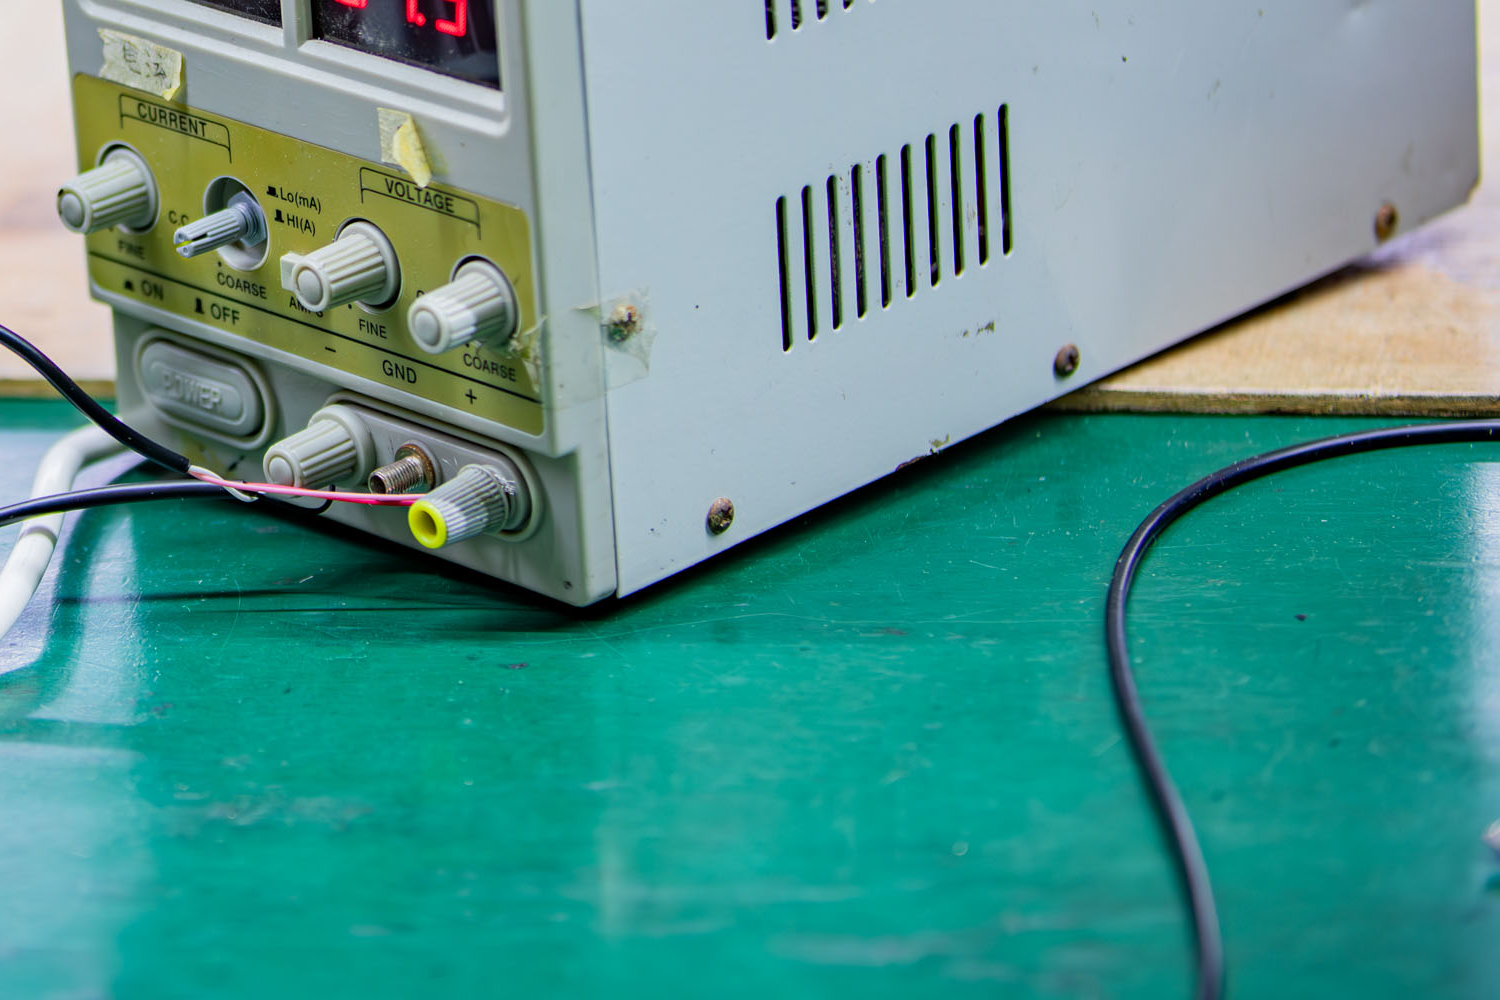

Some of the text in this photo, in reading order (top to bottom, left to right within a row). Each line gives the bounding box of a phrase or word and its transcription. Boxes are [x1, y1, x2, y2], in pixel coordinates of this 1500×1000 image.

[136, 102, 208, 138] CURRENT
[280, 187, 322, 215] Lo(mA)
[384, 178, 455, 214] VOLTAGE
[118, 240, 146, 261] FINE
[141, 279, 165, 301] ON
[216, 271, 268, 300] COARSE
[210, 303, 241, 326] OFF
[358, 318, 388, 340] FINE
[381, 359, 418, 384] GND
[463, 352, 517, 383] COARSE
[161, 367, 223, 412] POWER
